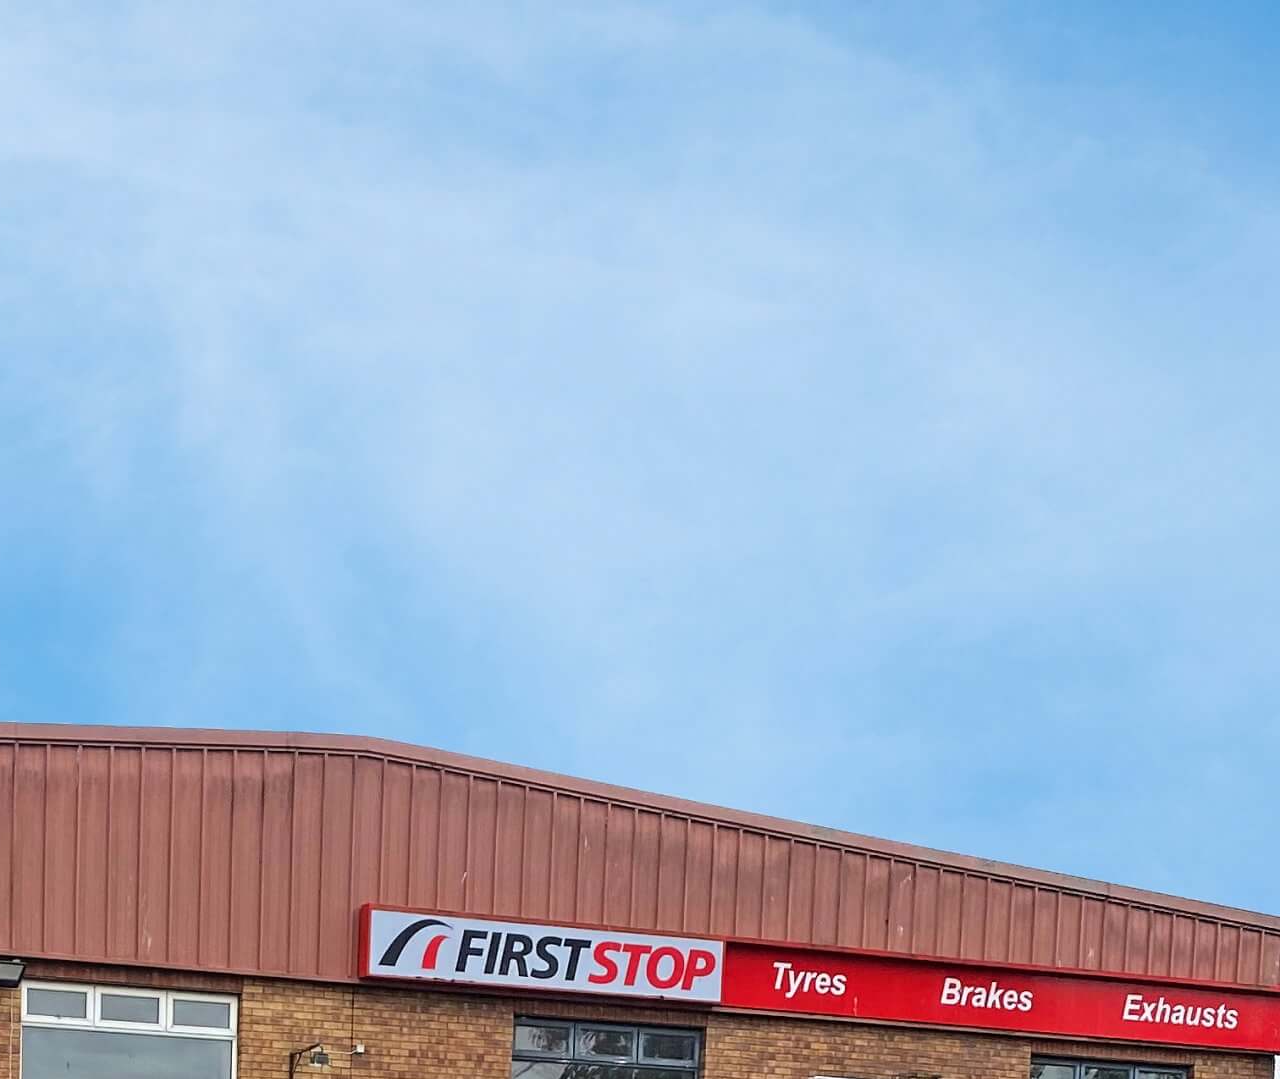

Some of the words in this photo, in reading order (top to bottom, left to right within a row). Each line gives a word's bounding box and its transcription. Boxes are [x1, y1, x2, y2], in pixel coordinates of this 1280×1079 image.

[772, 962, 847, 998] Tyres
[941, 978, 1033, 1011] Brakes
[1122, 994, 1239, 1030] Exhausts
